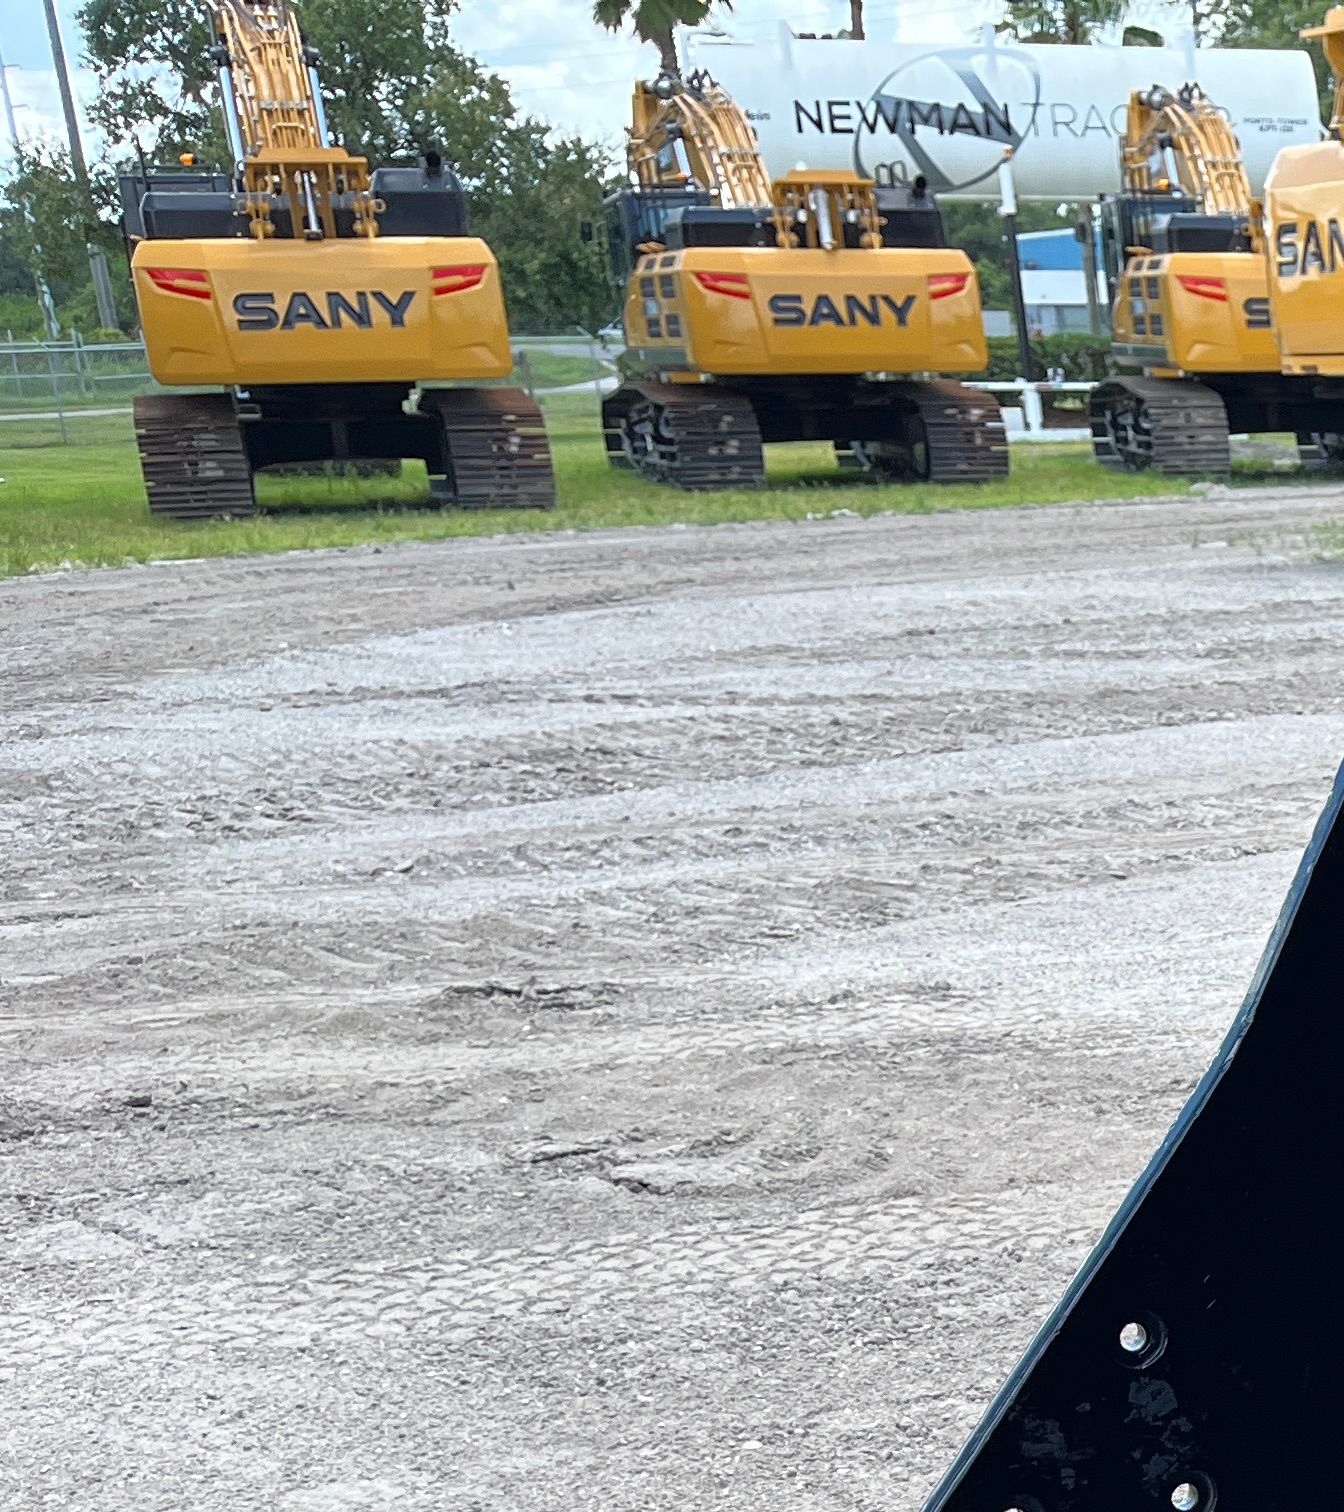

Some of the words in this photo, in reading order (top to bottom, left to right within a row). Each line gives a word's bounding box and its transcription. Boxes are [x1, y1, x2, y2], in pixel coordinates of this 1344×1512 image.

[793, 99, 1014, 136] NEWMAN
[232, 290, 418, 331] SANY
[768, 293, 918, 328] SANY
